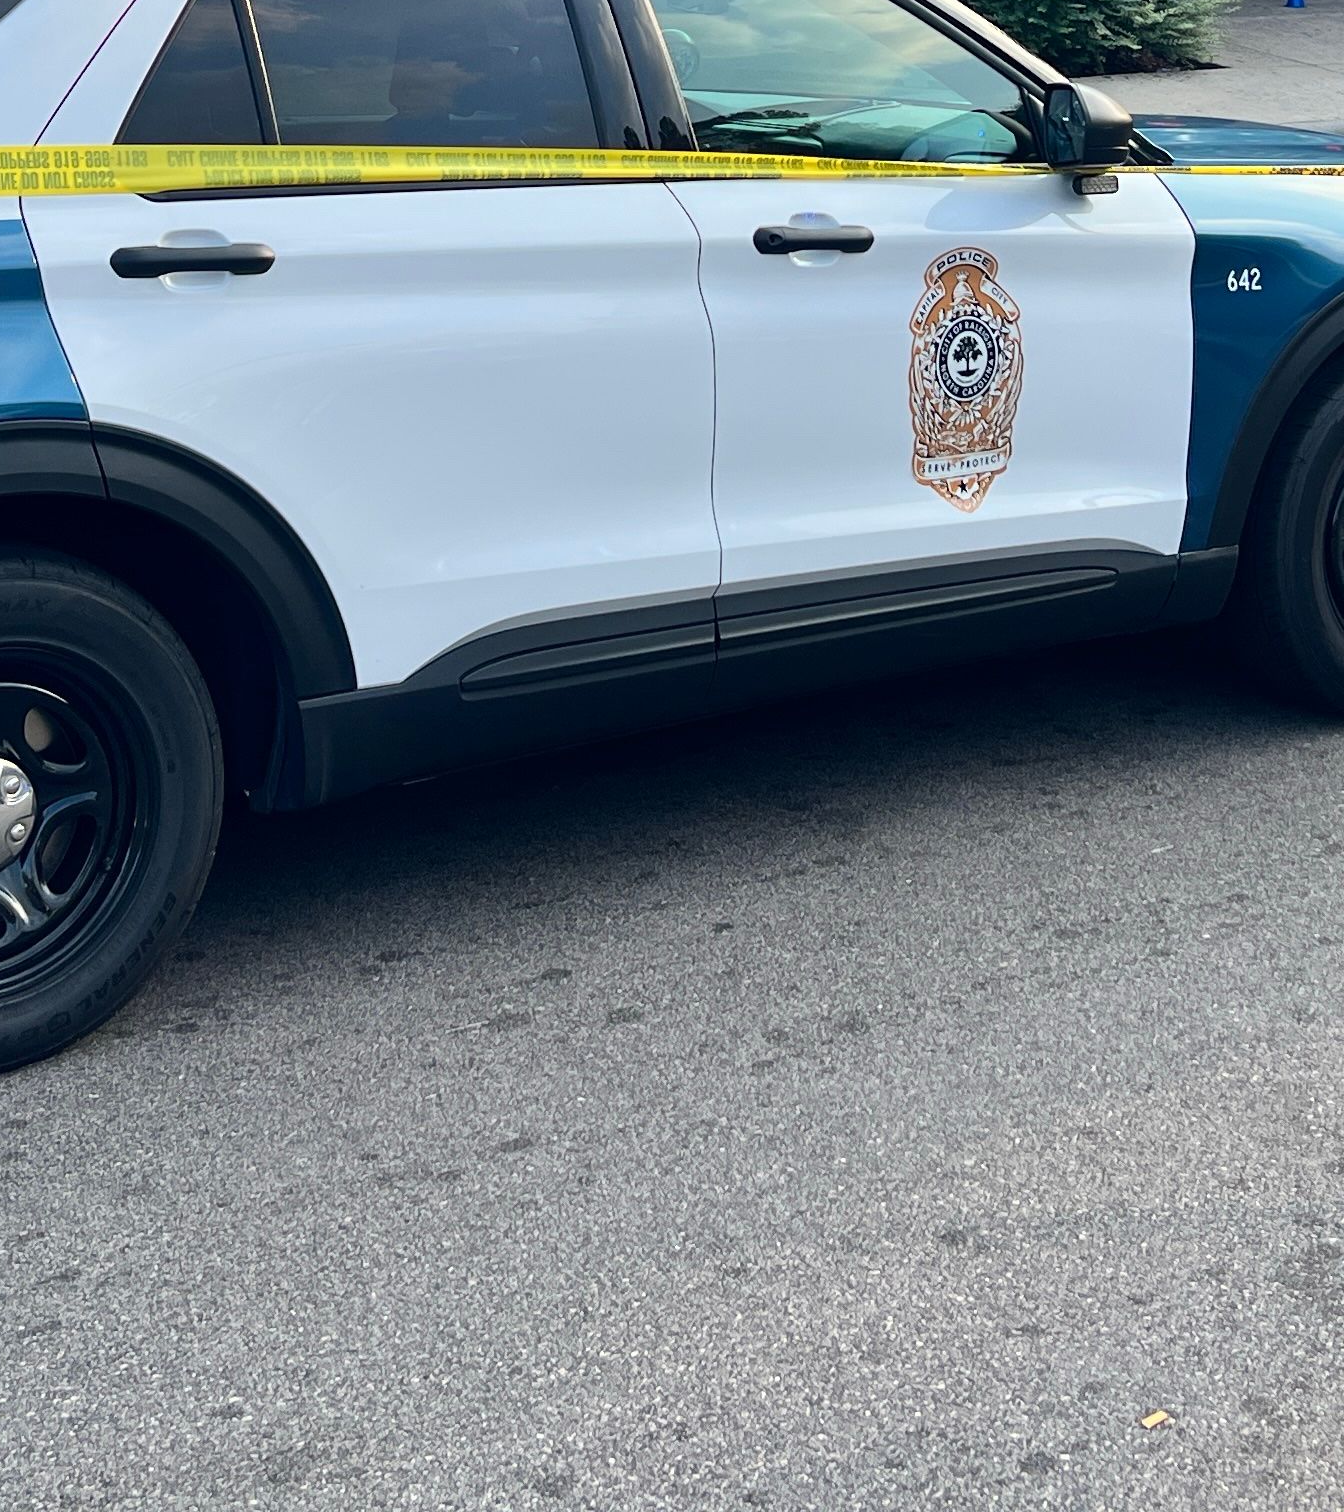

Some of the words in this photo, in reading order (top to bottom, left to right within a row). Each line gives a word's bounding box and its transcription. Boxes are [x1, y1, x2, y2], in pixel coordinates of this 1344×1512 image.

[936, 252, 992, 272] POLICE
[1227, 268, 1262, 292] 642
[991, 288, 1008, 305] CITY
[959, 453, 1001, 469] PROTECT
